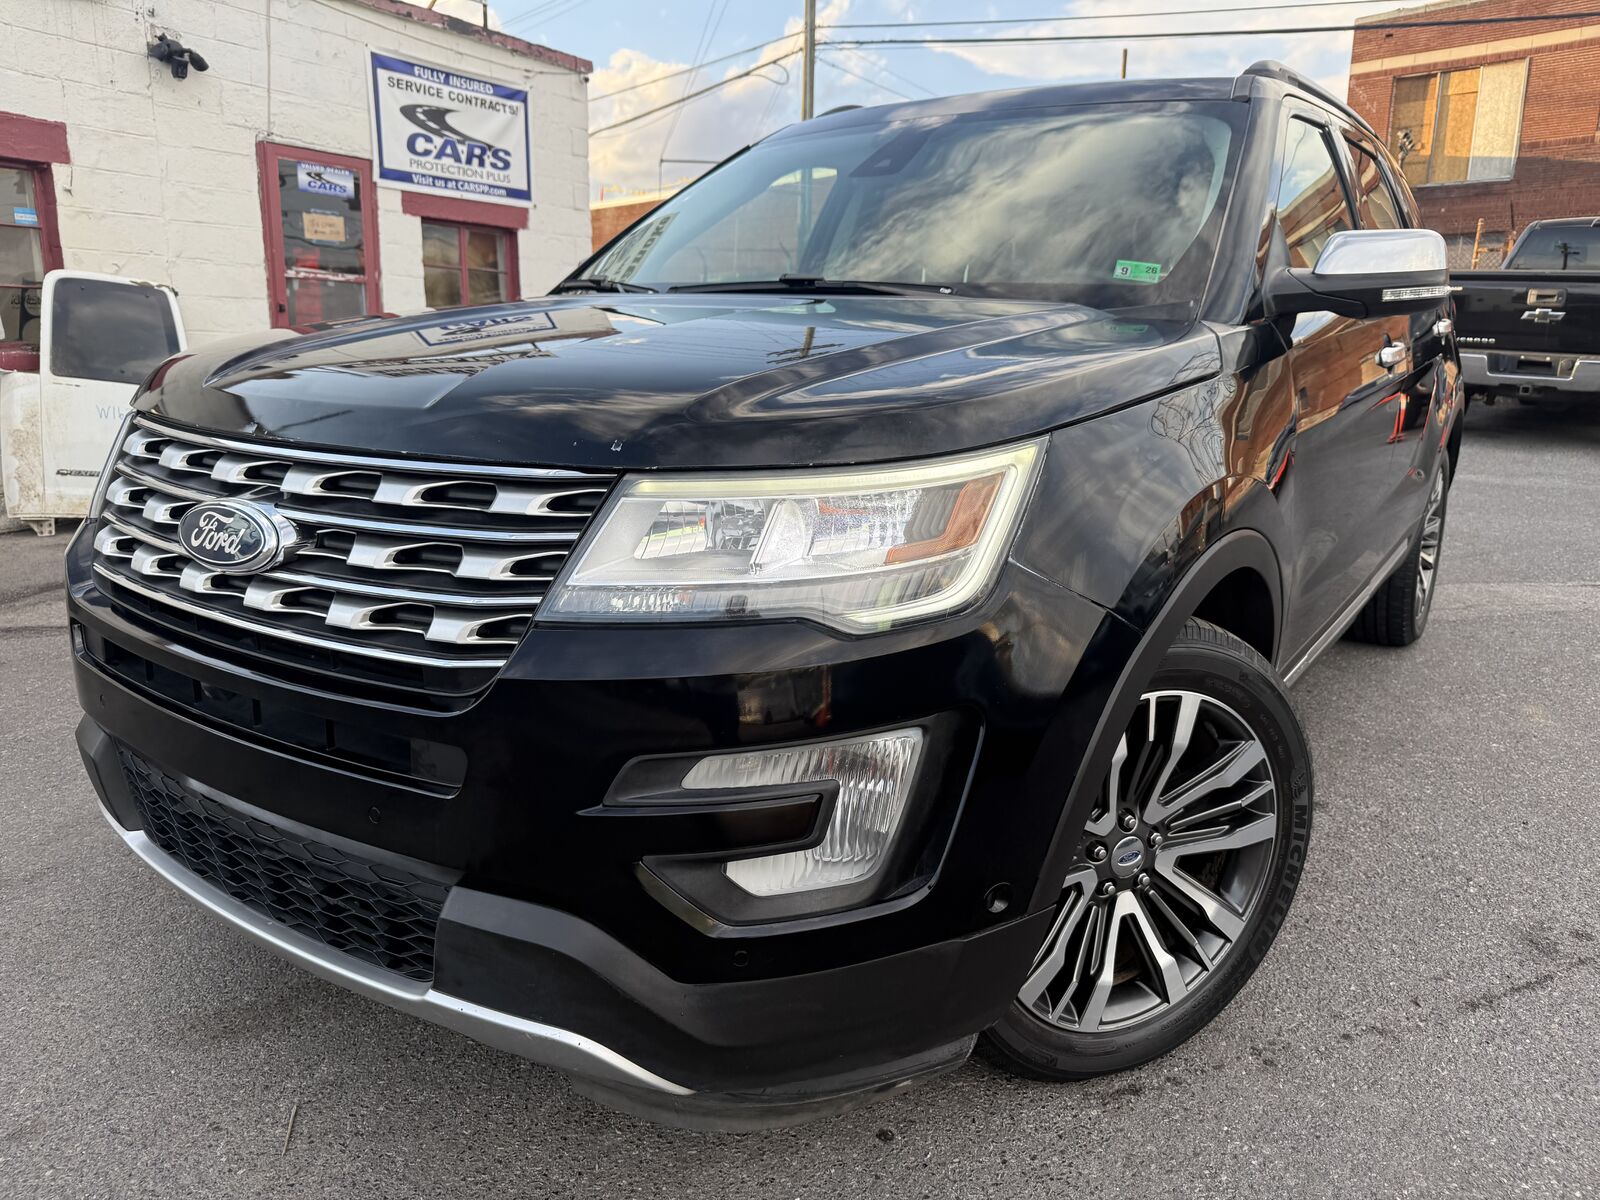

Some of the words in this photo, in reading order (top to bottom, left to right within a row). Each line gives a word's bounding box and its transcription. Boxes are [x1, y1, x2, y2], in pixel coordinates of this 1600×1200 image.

[387, 76, 443, 99] SERVICE
[413, 65, 446, 84] FULLY
[449, 75, 494, 94] INSURED
[409, 158, 484, 179] PROTECTION
[486, 171, 512, 184] PLUS
[307, 180, 347, 193] CARS
[411, 173, 433, 187] Visit
[434, 178, 445, 188] us
[446, 179, 457, 190] at
[457, 181, 507, 197] CARSPP.com
[191, 510, 246, 555] Ford
